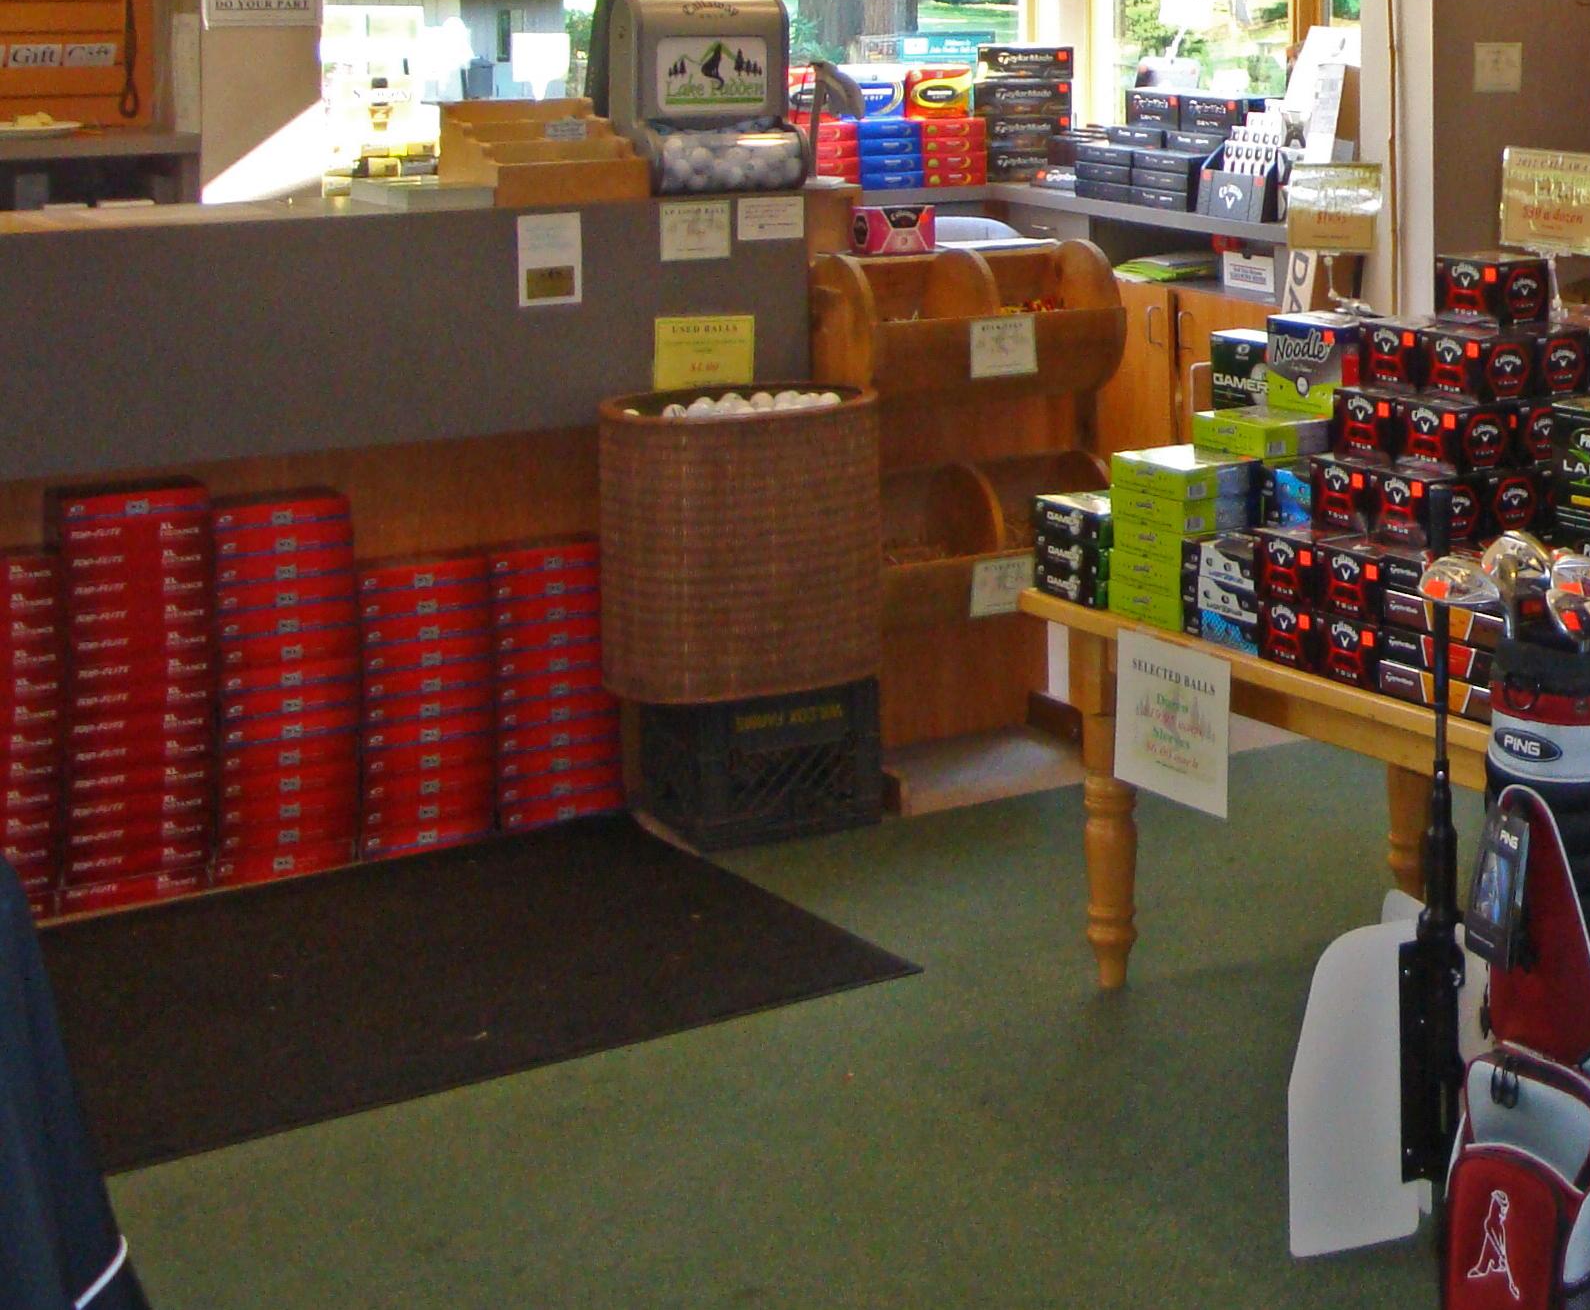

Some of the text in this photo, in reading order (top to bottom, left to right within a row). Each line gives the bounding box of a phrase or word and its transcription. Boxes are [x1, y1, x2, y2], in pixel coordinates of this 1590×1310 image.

[1452, 261, 1480, 280] Callaway
[1273, 328, 1329, 365] Noodle
[1373, 328, 1399, 346] Callaway
[1435, 338, 1462, 356] Callaway
[1347, 395, 1374, 415] Callaway
[1411, 407, 1440, 426] Callaway
[1324, 465, 1350, 485] Callaway
[1384, 477, 1411, 497] Callaway
[1268, 538, 1295, 558] Callaway
[1332, 554, 1361, 574] Callaway
[1271, 604, 1297, 624] Callaway
[1331, 621, 1359, 641] Callaway
[1132, 657, 1216, 696] SELECTED BALLS
[1504, 733, 1541, 757] PING
[1500, 828, 1520, 851] PING
